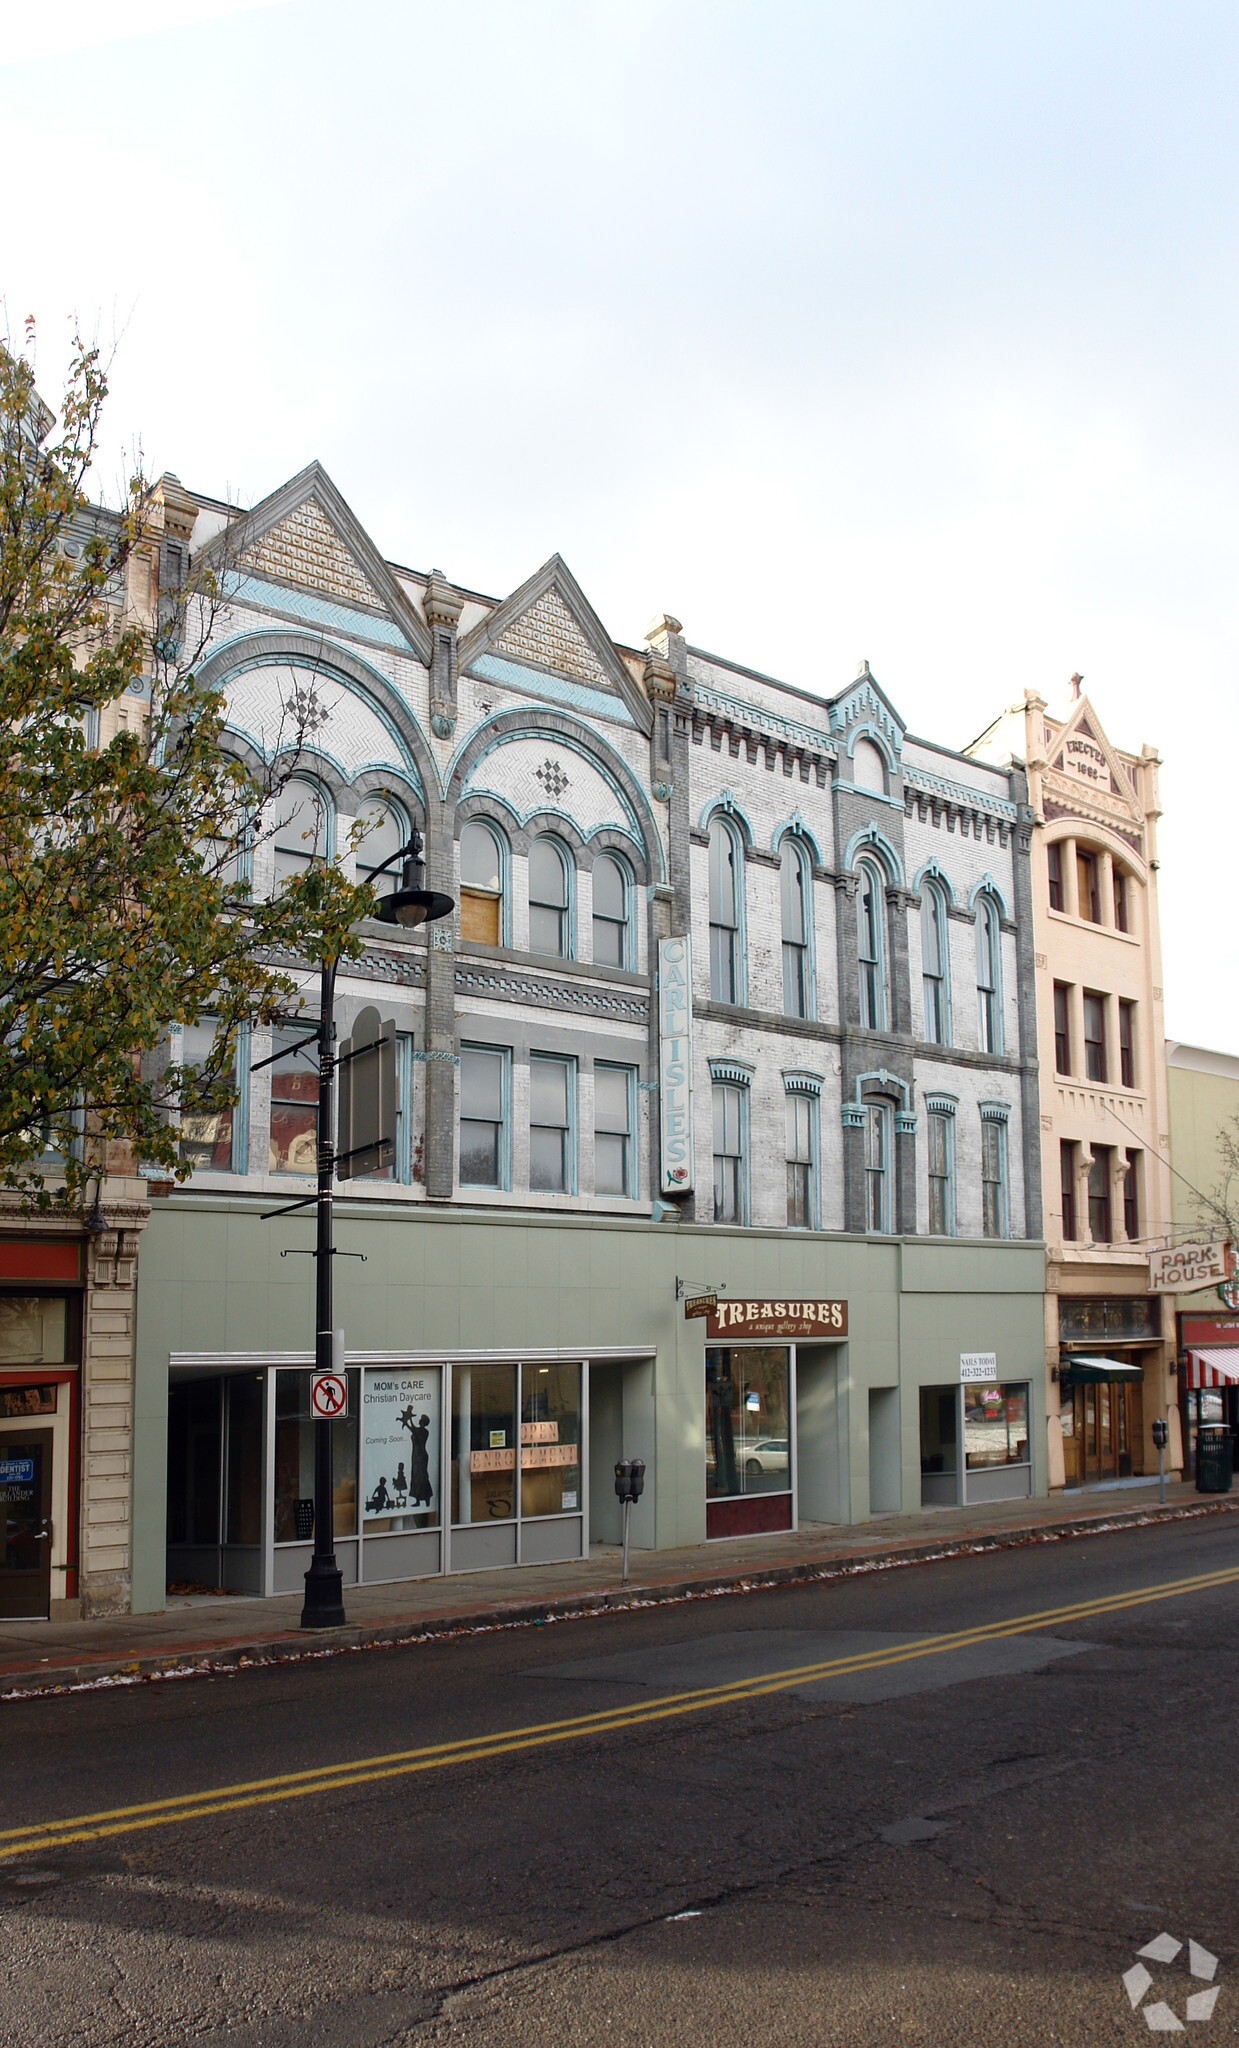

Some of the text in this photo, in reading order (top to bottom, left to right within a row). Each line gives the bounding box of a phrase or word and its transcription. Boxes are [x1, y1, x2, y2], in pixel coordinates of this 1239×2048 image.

[1066, 740, 1106, 767] ERECTED
[1153, 1263, 1224, 1288] HOUSE
[715, 1302, 843, 1329] TREASURES
[755, 1322, 774, 1333] unique
[777, 1320, 796, 1334] gallery
[799, 1319, 812, 1334] shop
[961, 1357, 996, 1366] NAILS TODAY
[374, 1380, 425, 1391] MOM's CARE
[363, 1392, 432, 1404] Christian Daycare
[520, 1423, 557, 1441] OPEN
[365, 1437, 388, 1445] Coming
[0, 1464, 30, 1474] DENTIST
